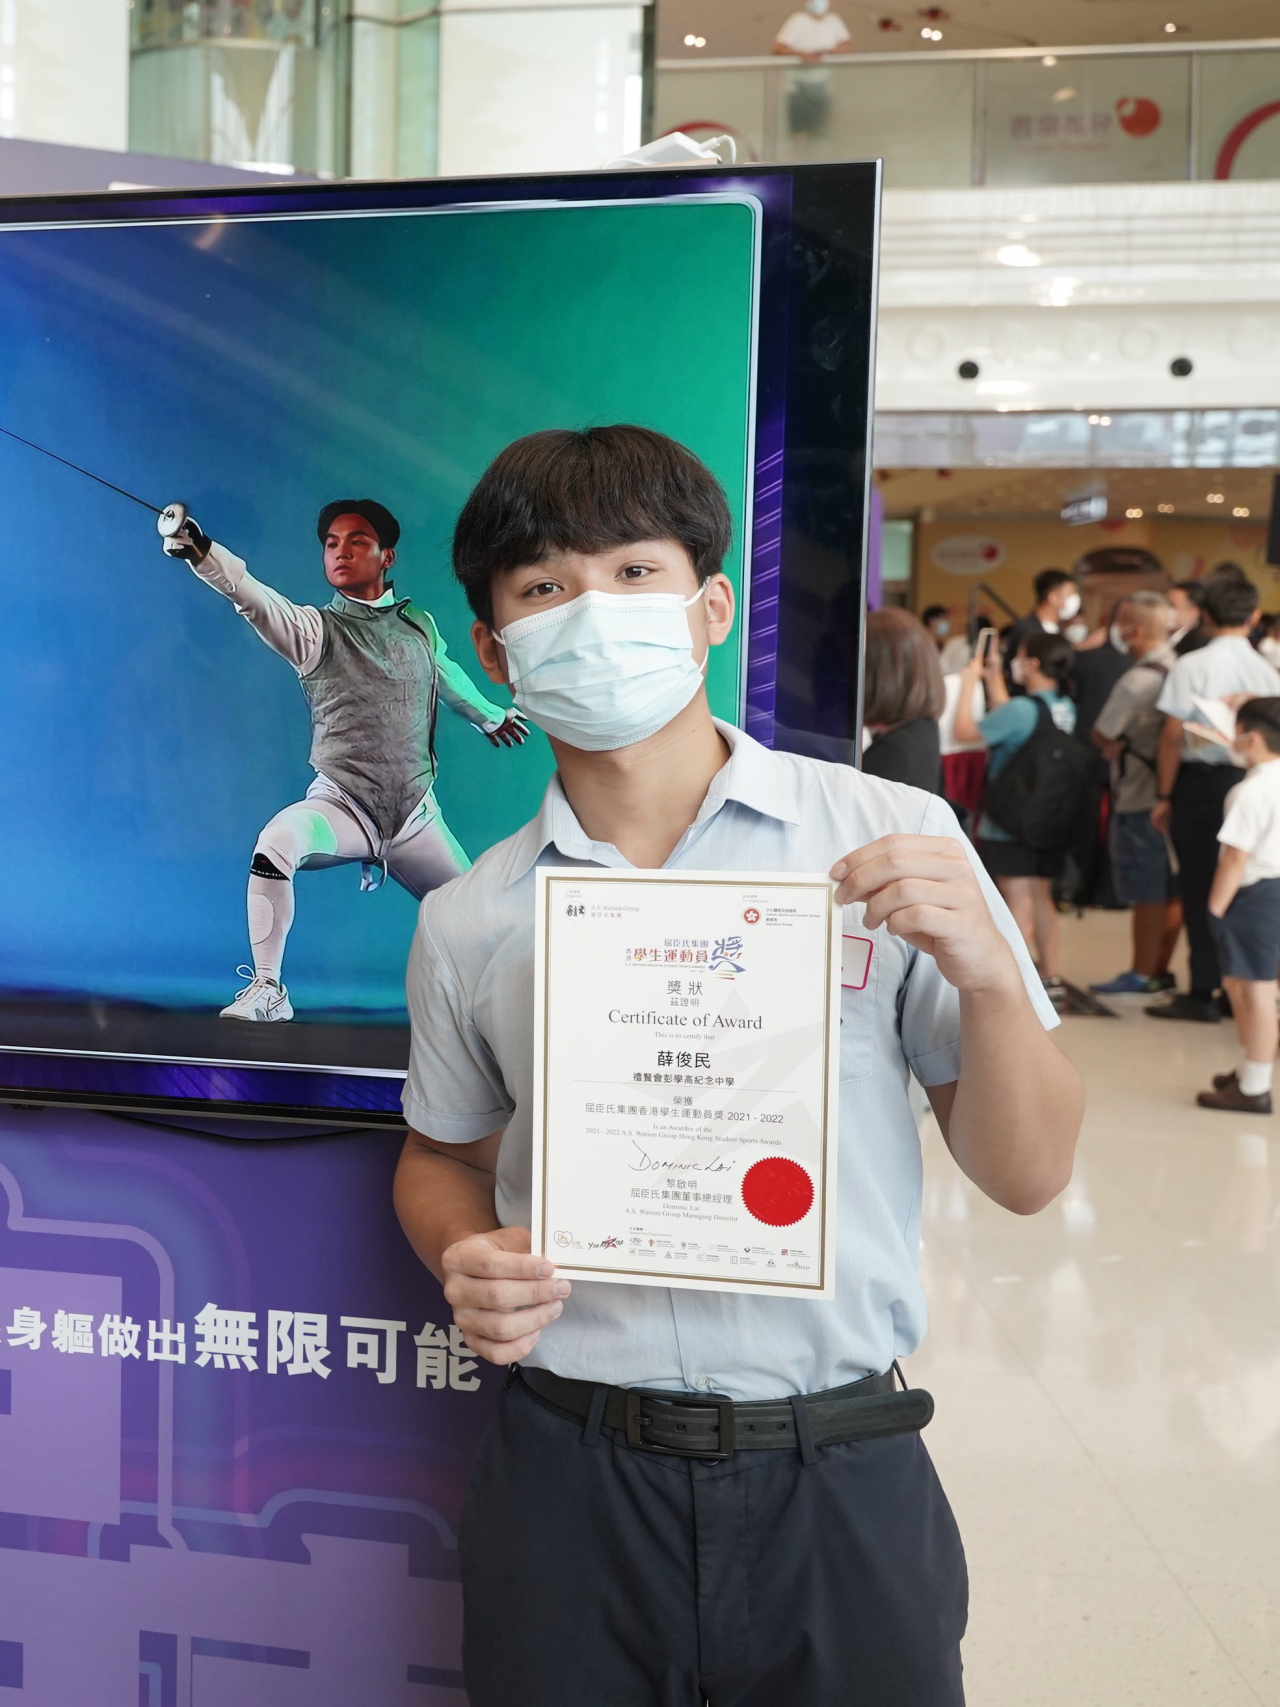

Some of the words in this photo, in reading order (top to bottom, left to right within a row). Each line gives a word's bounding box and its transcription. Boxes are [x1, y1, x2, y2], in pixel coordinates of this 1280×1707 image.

[664, 939, 709, 948] 屈臣氏集團
[634, 948, 708, 963] 學生運動員
[608, 1010, 688, 1027] Certificate
[692, 1013, 710, 1027] of
[713, 1014, 763, 1030] Award
[683, 1033, 702, 1041] certify
[657, 1050, 711, 1069] 薛俊民
[633, 1072, 735, 1086] 禮賢會彭學高紀念中學
[673, 1096, 694, 1106] 榮獲
[585, 1102, 724, 1120] 屈臣氏集團香港學生運動員獎
[727, 1111, 751, 1122] 2021
[760, 1113, 784, 1124] 2022
[659, 1132, 677, 1140] Group
[679, 1133, 695, 1141] Hong
[697, 1134, 713, 1142] Kong
[631, 1188, 733, 1204] 屈臣氏集團董事總經理
[663, 1203, 688, 1211] Dominic
[662, 1210, 681, 1219] Group
[682, 1212, 712, 1221] Managing
[713, 1214, 738, 1222] Director
